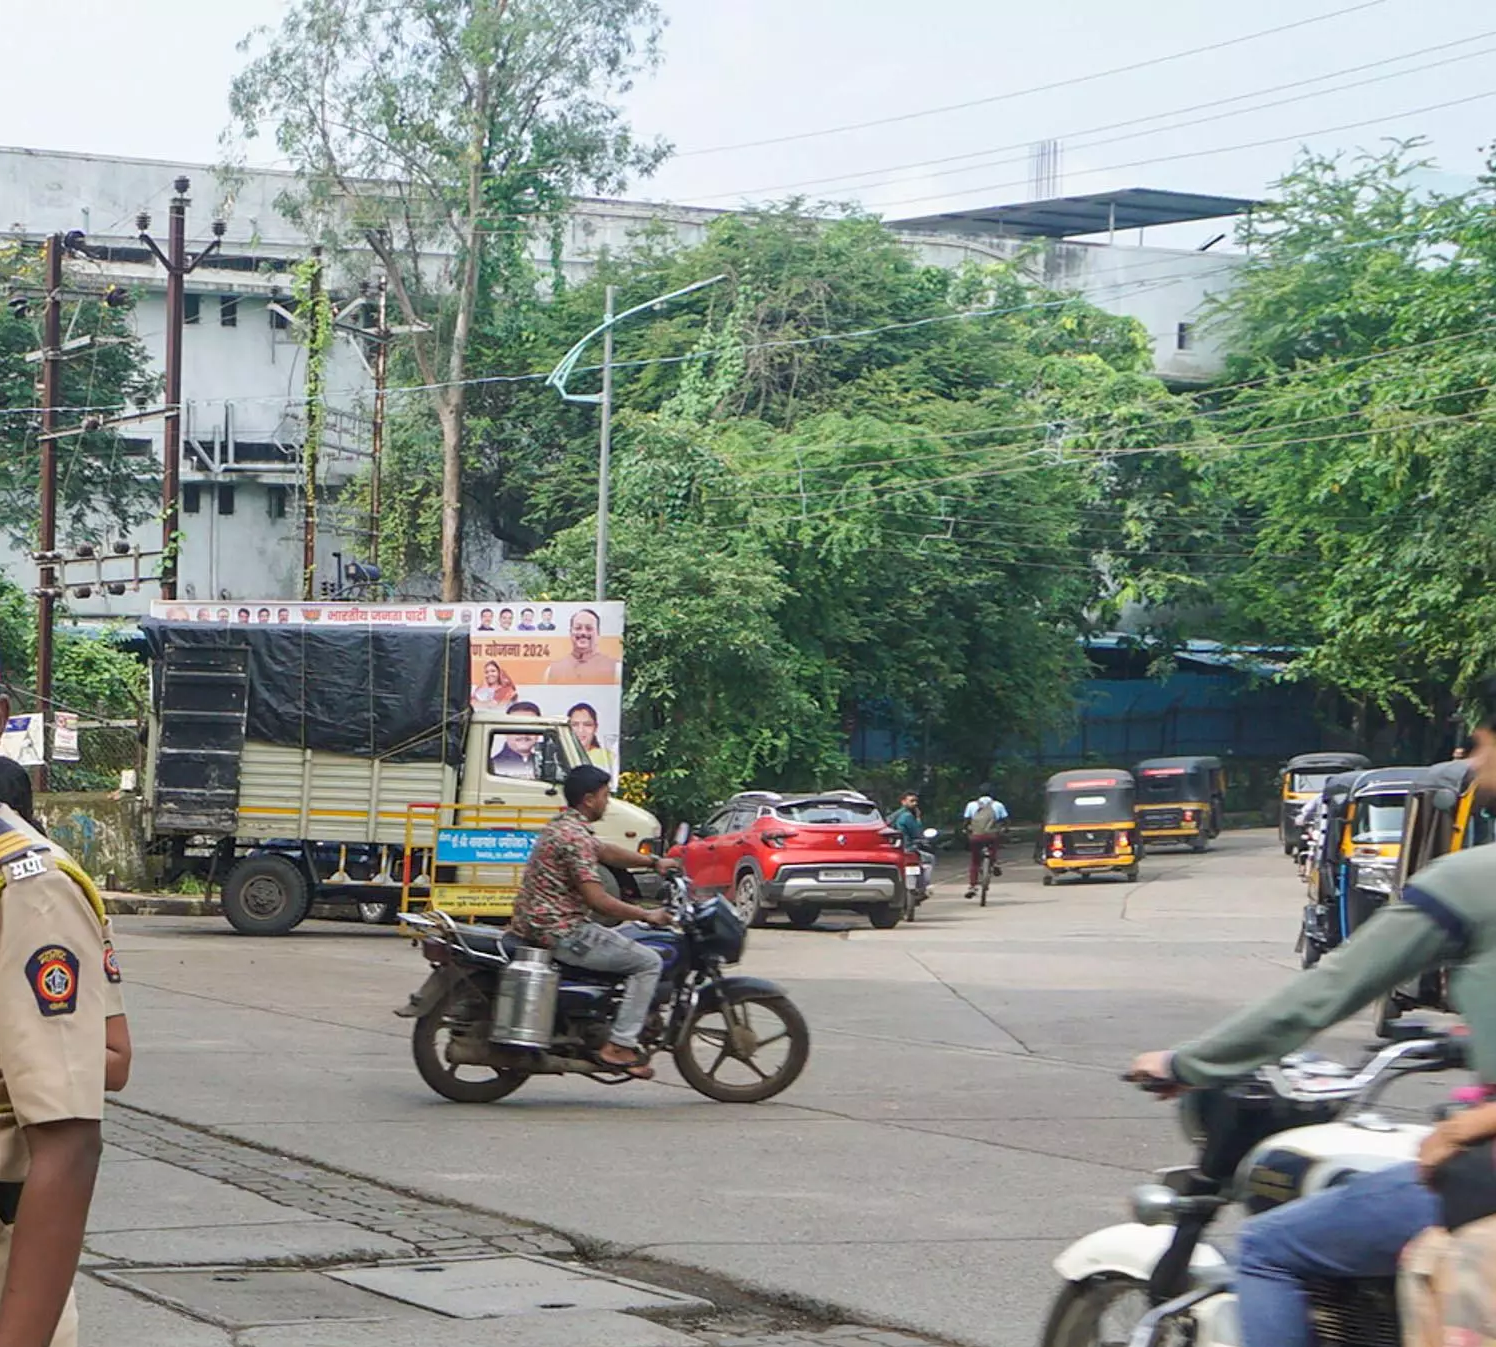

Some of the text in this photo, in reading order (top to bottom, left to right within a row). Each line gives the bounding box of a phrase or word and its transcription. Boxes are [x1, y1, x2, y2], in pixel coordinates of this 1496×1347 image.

[371, 610, 402, 621] जनता
[485, 640, 521, 656] योजना
[523, 644, 550, 657] 2024
